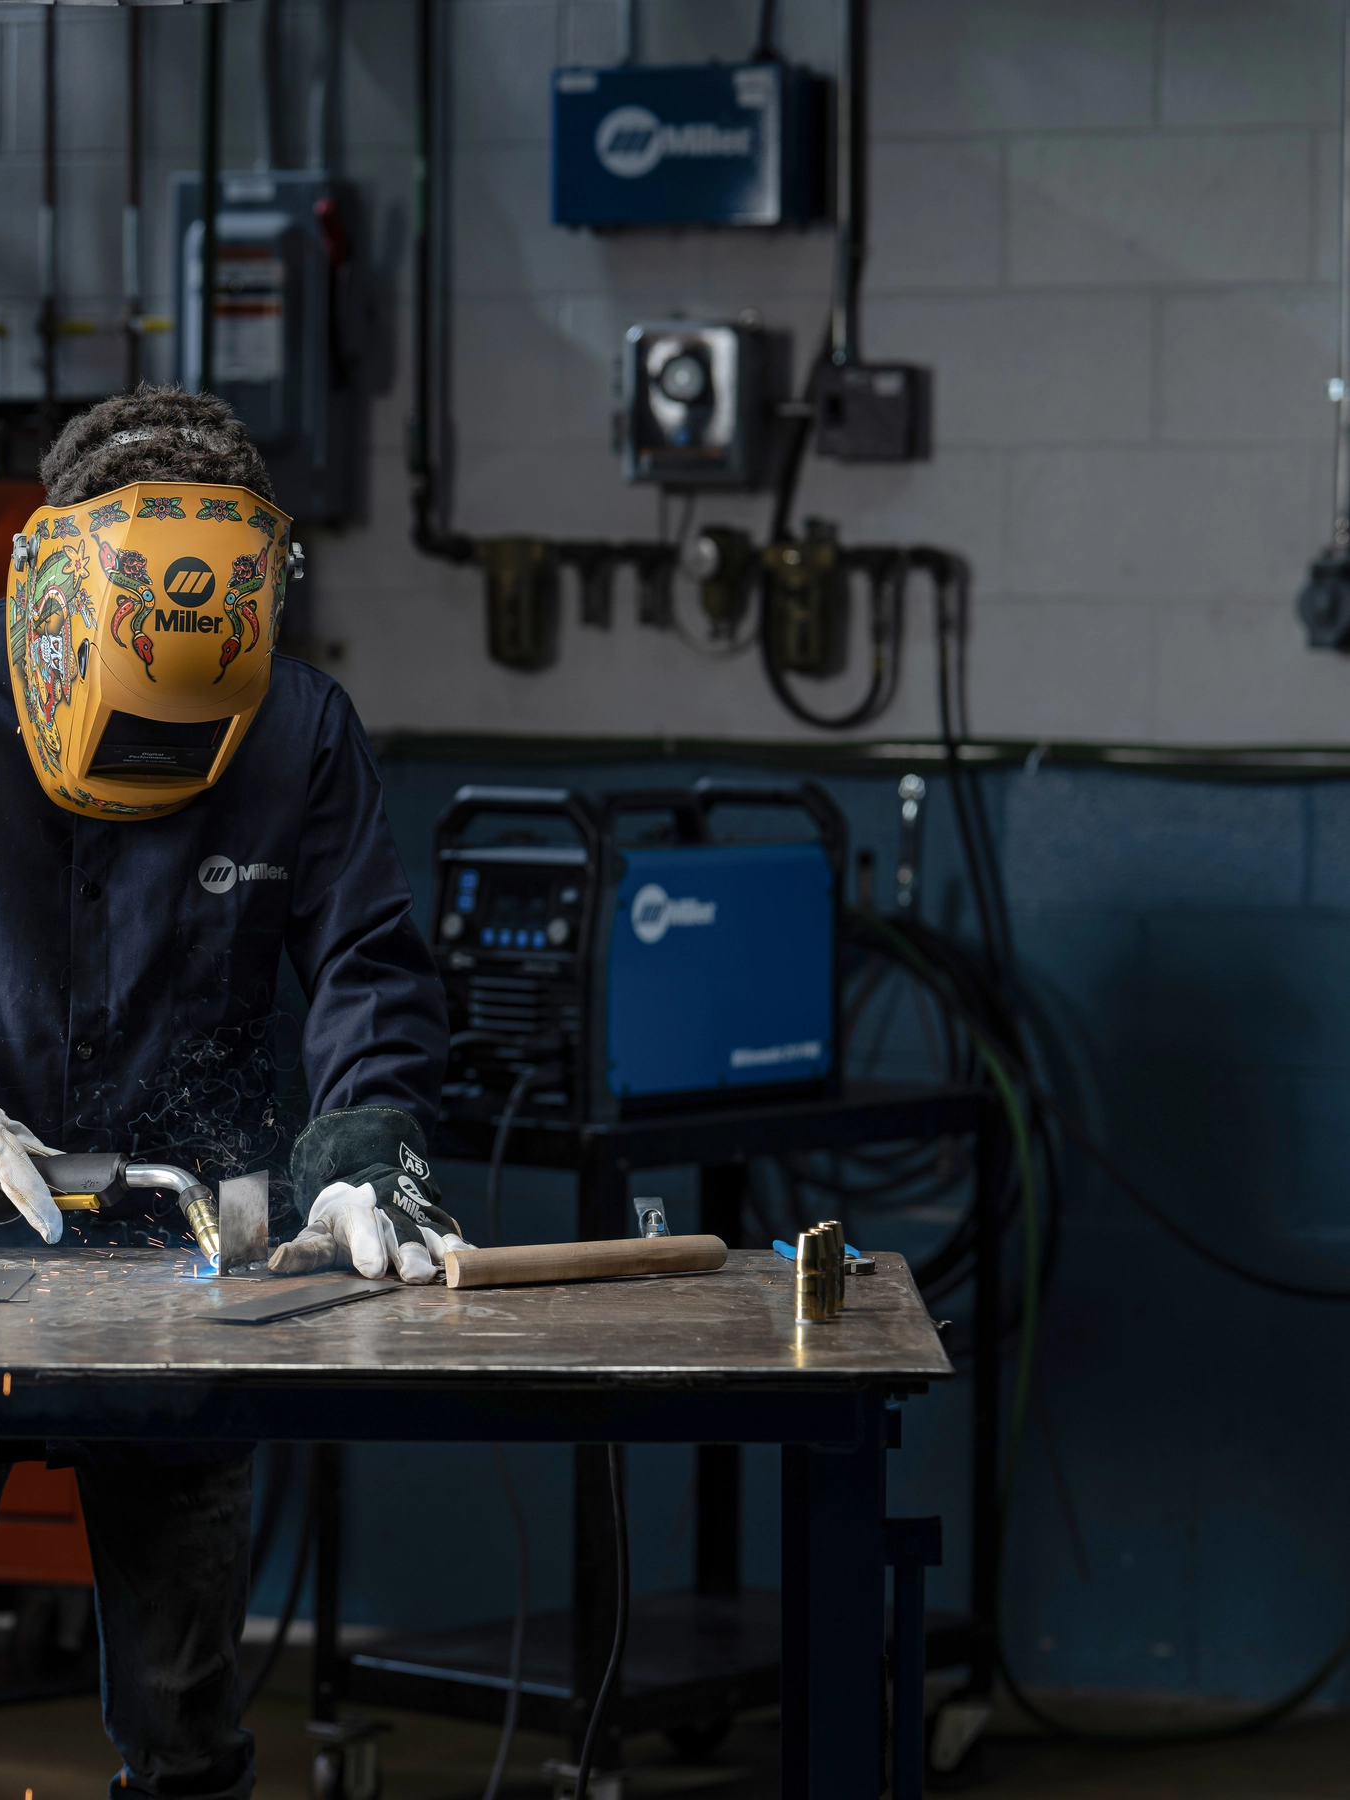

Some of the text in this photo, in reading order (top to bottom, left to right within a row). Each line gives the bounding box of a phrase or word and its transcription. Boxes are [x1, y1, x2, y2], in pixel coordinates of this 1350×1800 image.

[154, 609, 224, 634] Miller
[238, 862, 285, 881] Miller
[405, 1157, 424, 1176] A5
